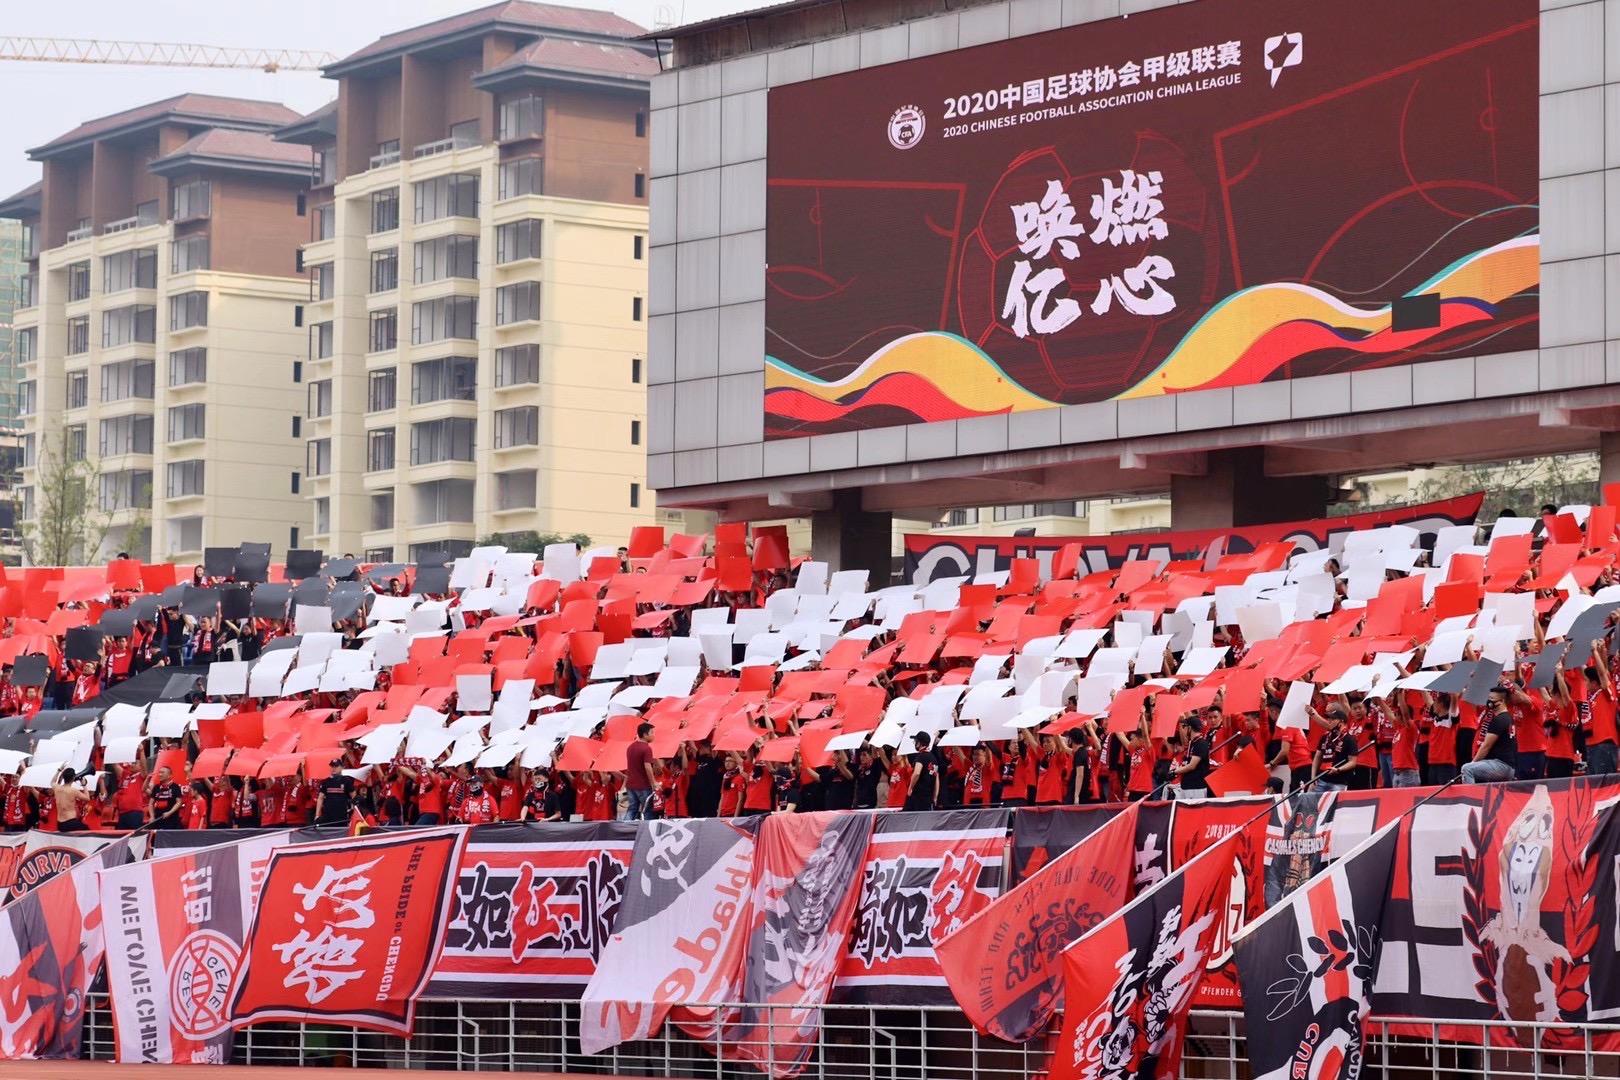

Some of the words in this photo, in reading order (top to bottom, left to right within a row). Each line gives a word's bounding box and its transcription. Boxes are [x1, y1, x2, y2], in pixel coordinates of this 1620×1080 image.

[943, 41, 1241, 119] 2020中国足球协会甲级联赛
[943, 124, 968, 138] 2020
[970, 115, 1017, 132] CHINESE
[1020, 104, 1076, 124] FOOTBALL
[1078, 90, 1153, 113] ASSOCIATION
[1157, 82, 1193, 98] CHINA
[1196, 73, 1241, 91] LEAGUE
[10, 851, 72, 898] CURVA
